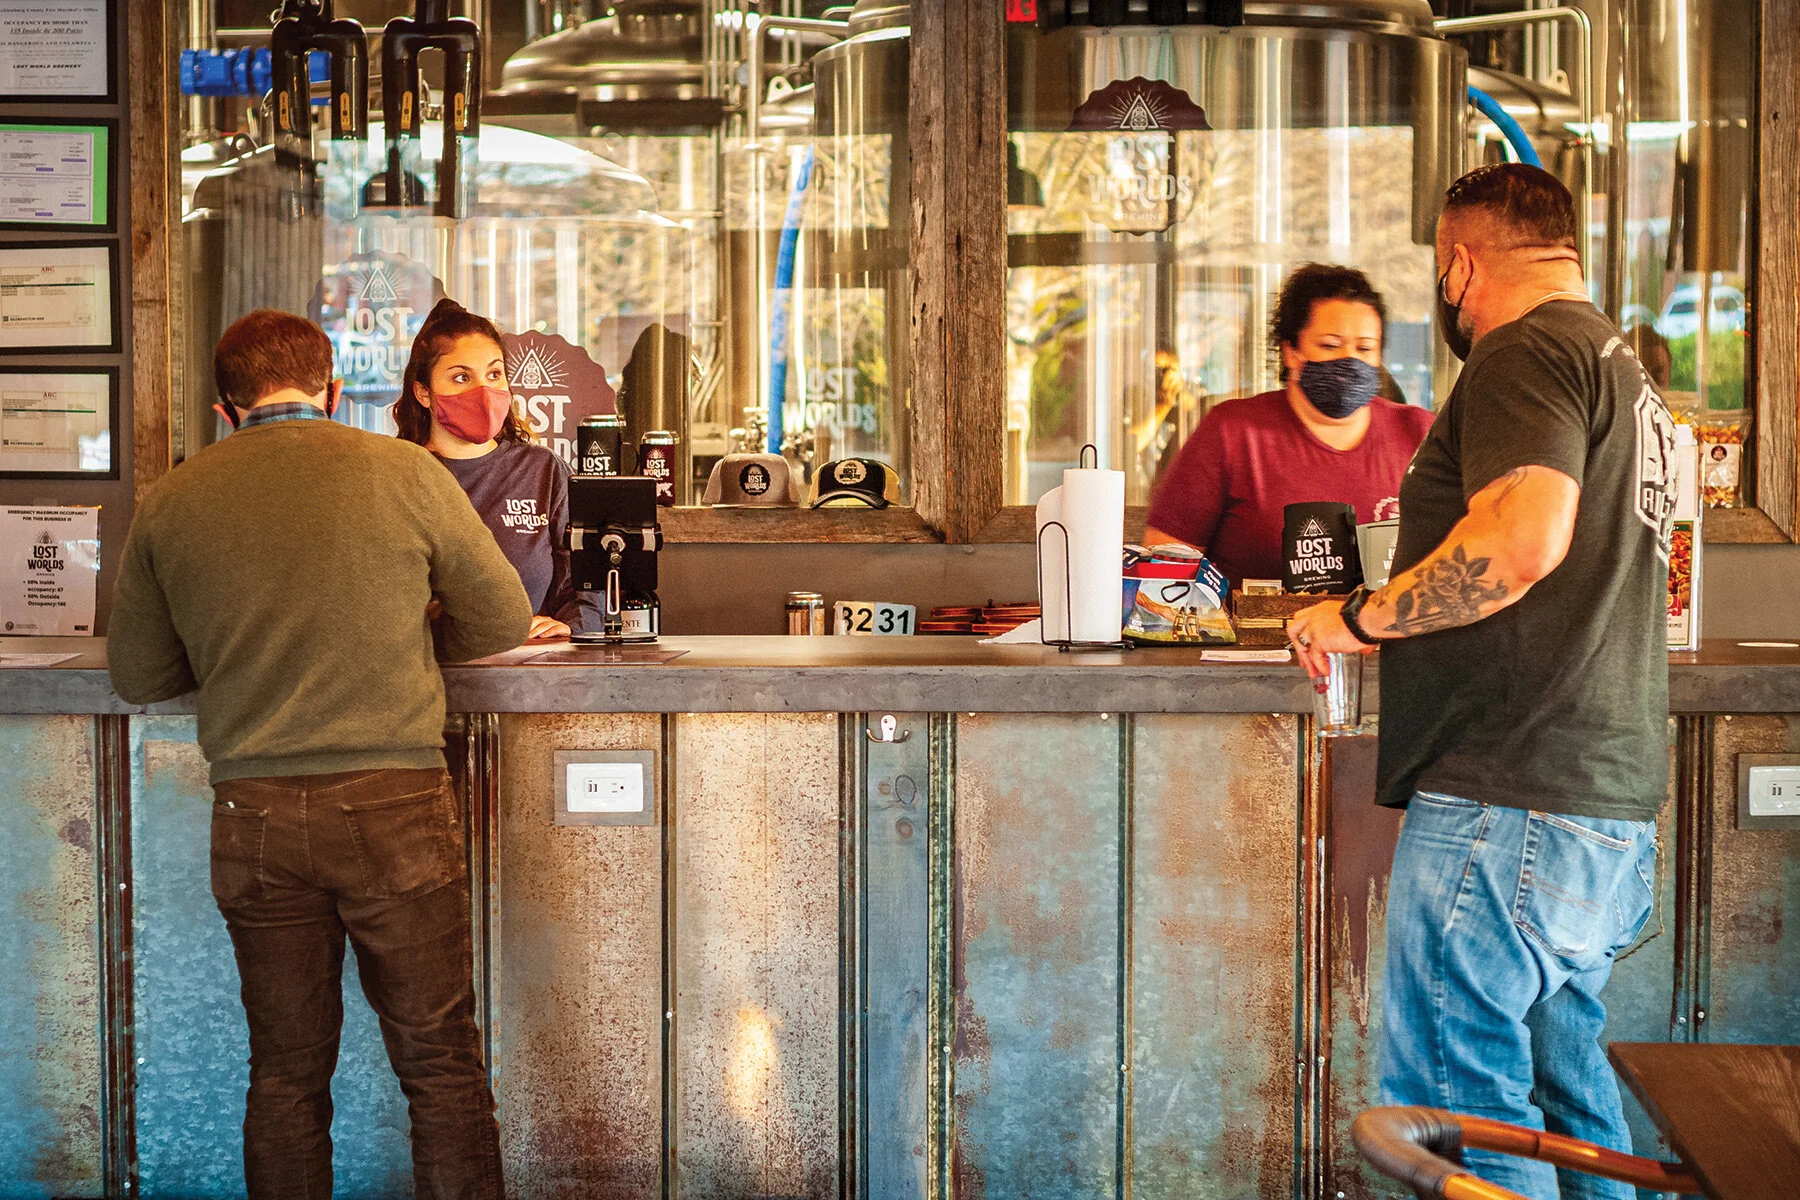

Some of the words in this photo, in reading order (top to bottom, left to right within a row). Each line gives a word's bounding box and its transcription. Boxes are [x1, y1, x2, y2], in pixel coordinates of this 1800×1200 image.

[1105, 135, 1176, 173] LOST
[1088, 174, 1192, 209] WORLDS
[346, 307, 414, 343] LOST
[332, 346, 412, 380] WORLD
[354, 384, 402, 392] BREWIN
[513, 395, 572, 434] OST
[782, 401, 876, 440] WORLDS
[582, 456, 611, 472] LOST
[646, 459, 666, 469] LOST
[643, 468, 670, 478] WORLDS
[748, 474, 763, 483] LOST
[505, 498, 538, 515] LOST
[500, 513, 549, 530] WORLDS
[33, 545, 58, 559] LOST
[1295, 538, 1333, 558] LOST
[27, 559, 64, 572] WORLDS
[1289, 556, 1344, 575] WORLDS
